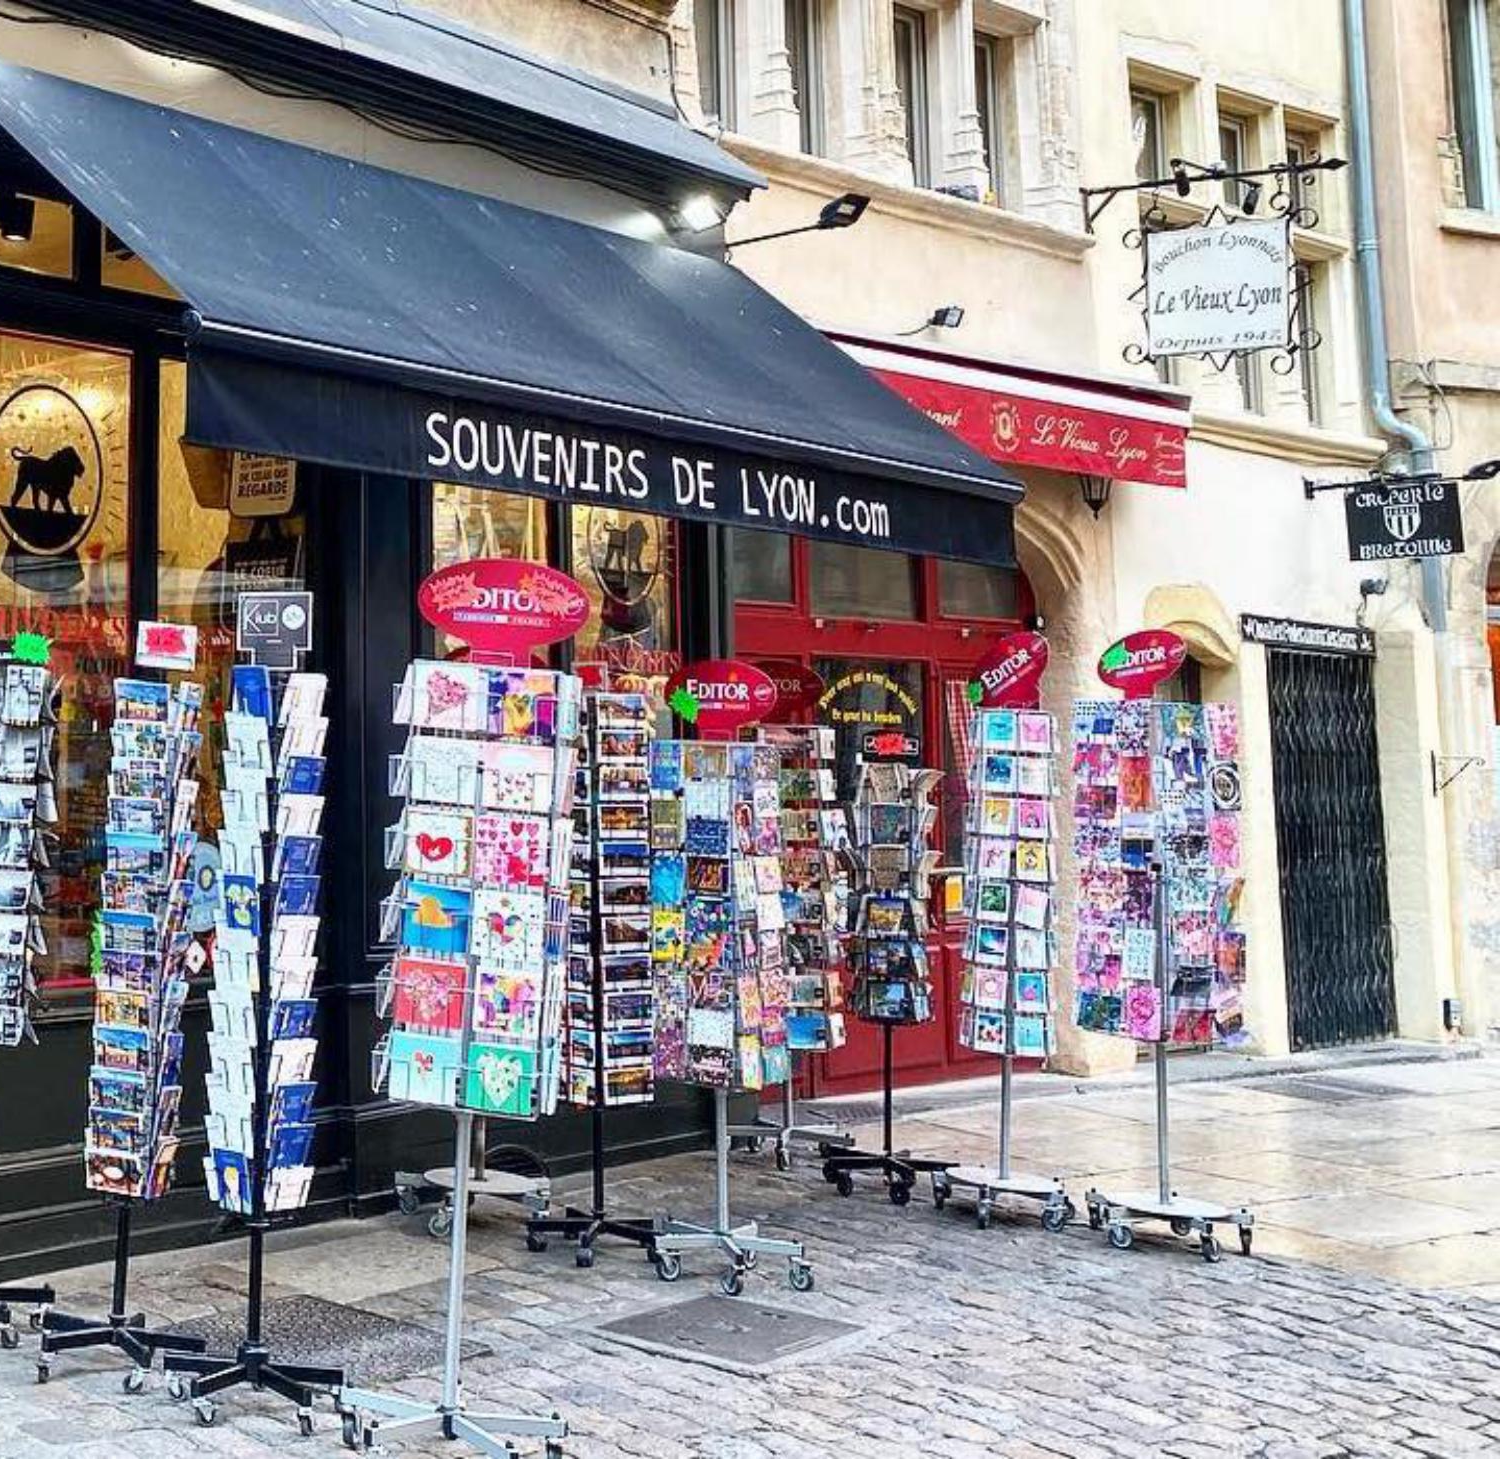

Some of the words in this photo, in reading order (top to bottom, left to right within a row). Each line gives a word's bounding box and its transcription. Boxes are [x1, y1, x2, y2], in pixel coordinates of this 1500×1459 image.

[1153, 236, 1212, 275] Bouchon
[1218, 231, 1284, 264] Lyonnais
[1153, 291, 1176, 315] Le
[1180, 285, 1234, 313] Vieux
[1235, 283, 1283, 315] Lyon
[1156, 336, 1224, 350] Depuis
[1031, 415, 1055, 444] Le
[1057, 418, 1100, 454] Vieux
[1105, 427, 1149, 469] Lyon
[238, 480, 288, 498] REGARDE
[425, 412, 649, 499] SOUVENIRS
[672, 456, 716, 510] DE
[740, 467, 891, 537] LYON.com
[980, 648, 1033, 690] EDITOR
[1117, 646, 1167, 668] DITOR
[686, 679, 750, 701] EDITOR
